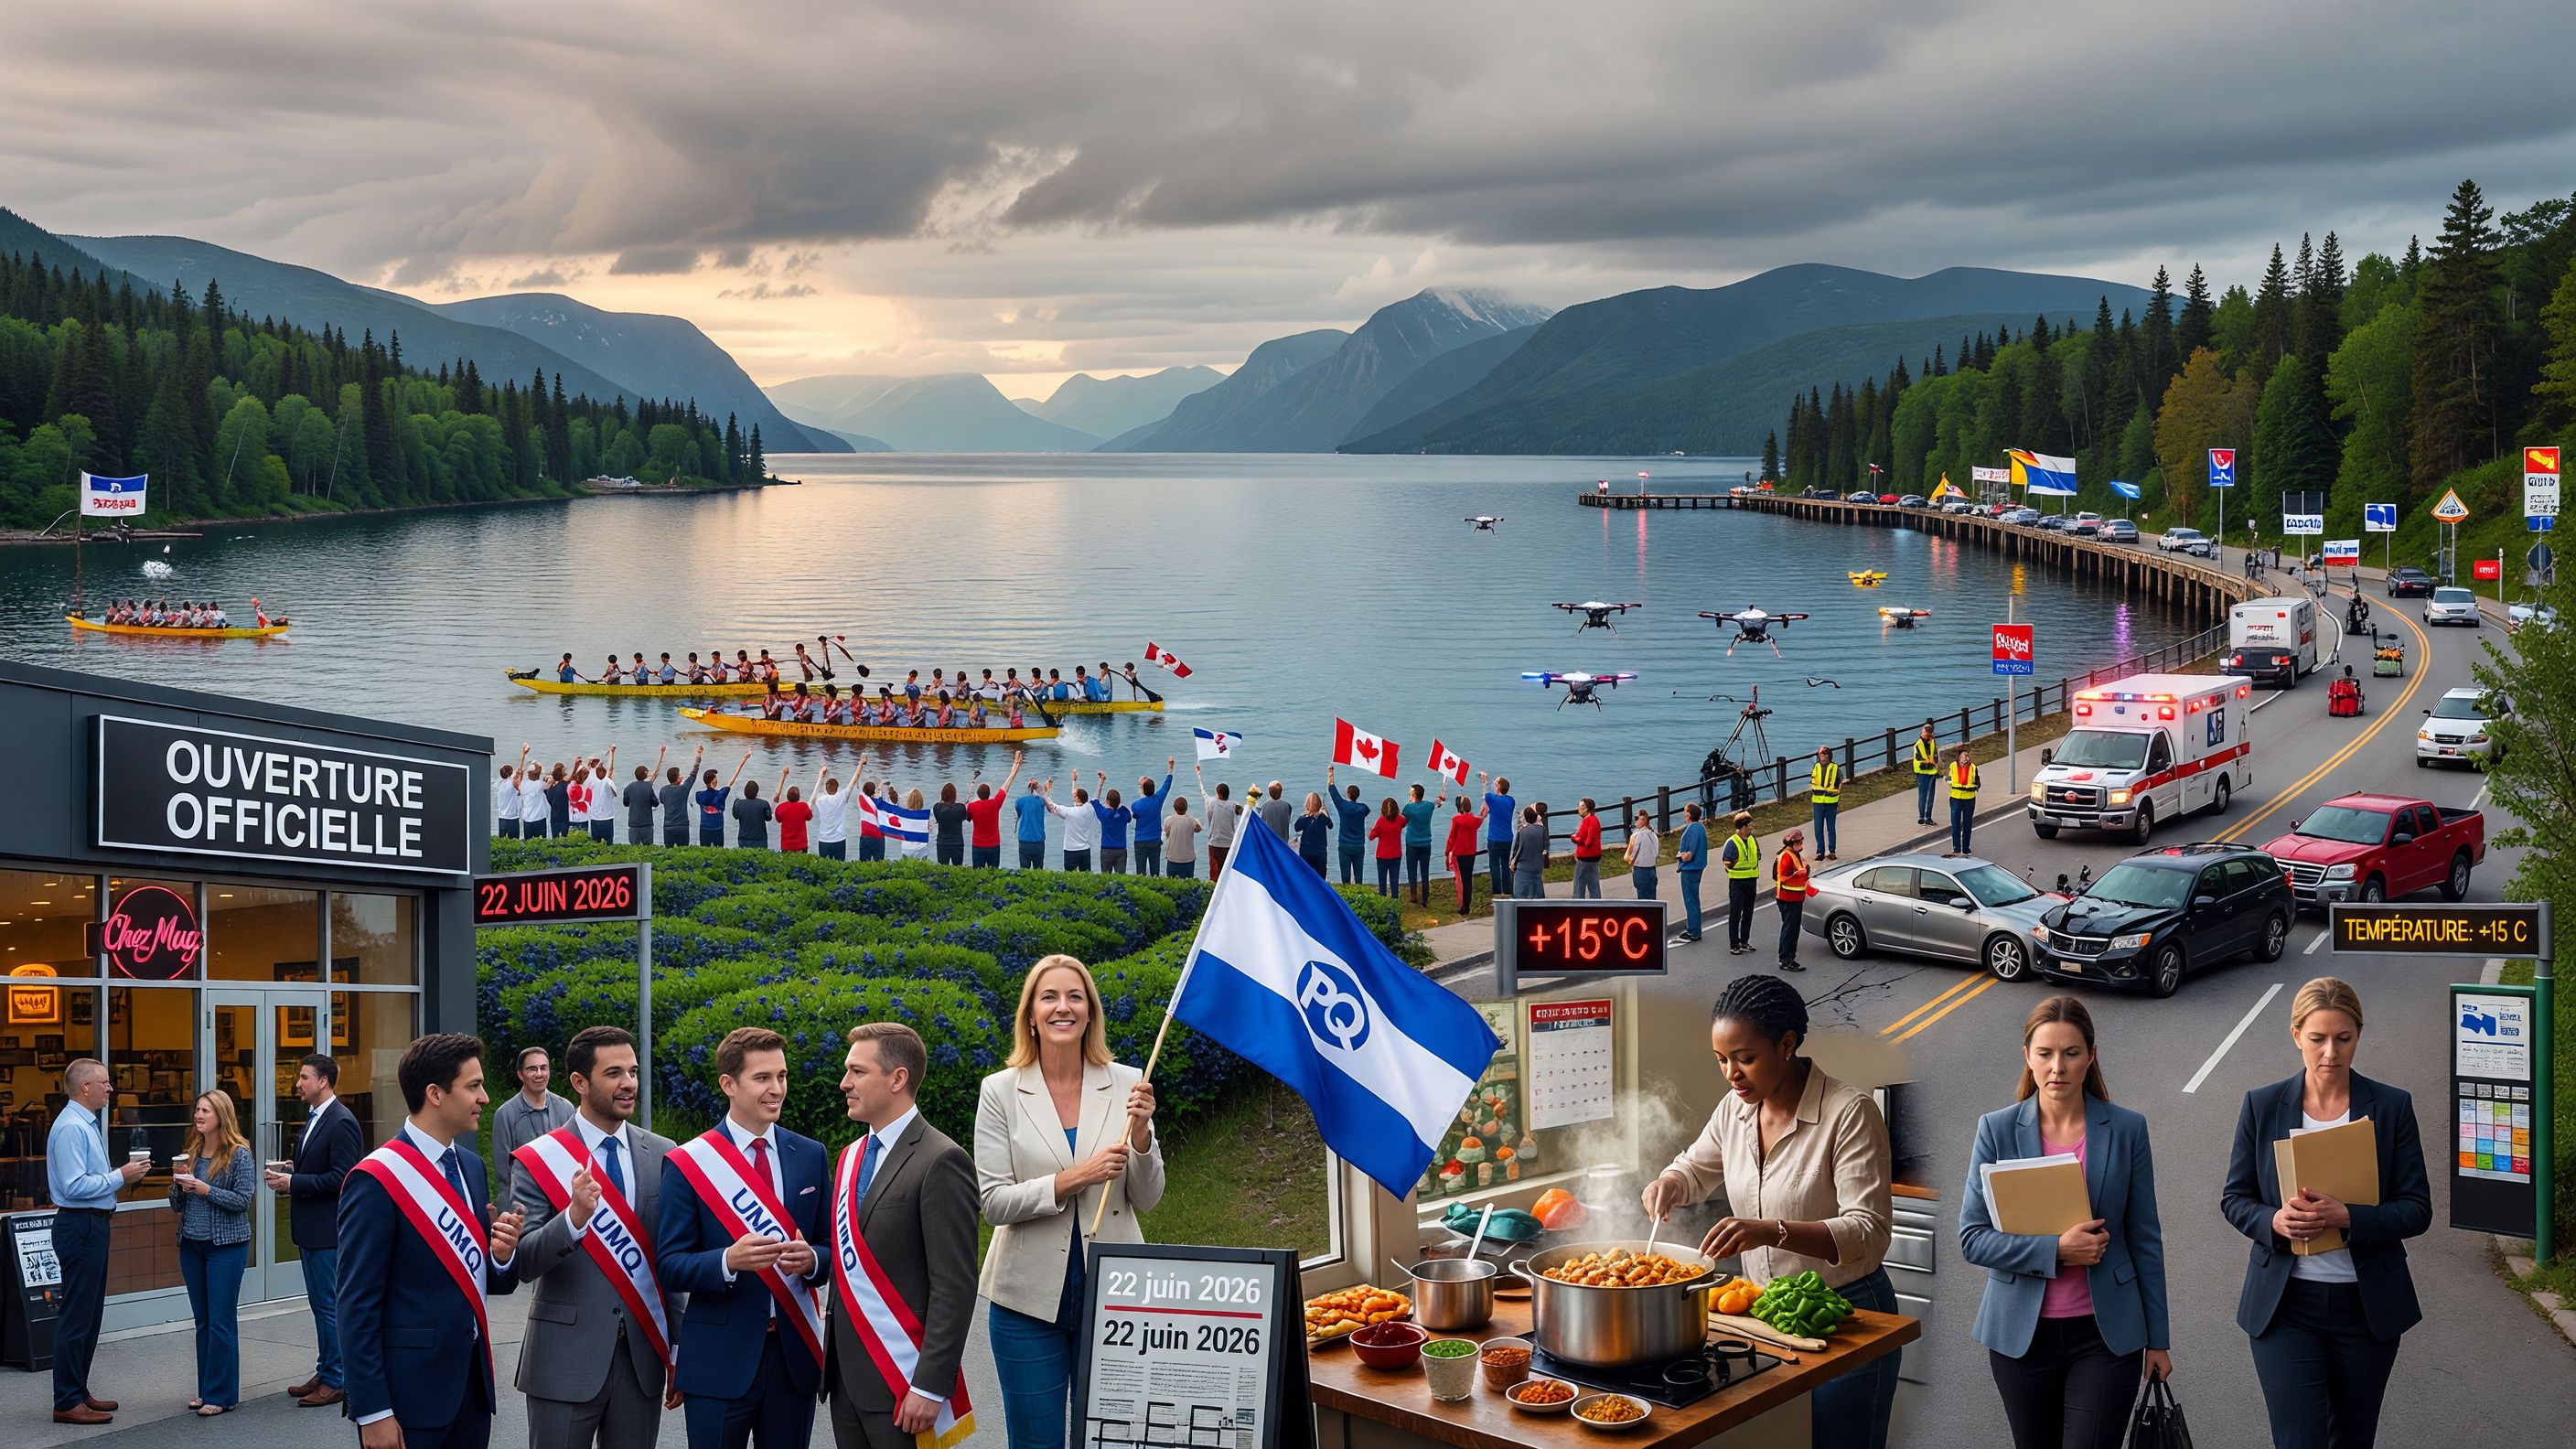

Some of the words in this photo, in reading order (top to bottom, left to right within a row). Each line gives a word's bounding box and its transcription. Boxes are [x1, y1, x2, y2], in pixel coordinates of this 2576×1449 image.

[166, 739, 424, 810] OUVERTURE
[166, 792, 423, 857] OFFICIELLE
[481, 884, 508, 916] 22
[514, 880, 566, 914] JUIN
[574, 875, 630, 910] 2026
[104, 913, 152, 950] Chez
[134, 915, 200, 963] Mug
[1529, 917, 1648, 960] +15°C
[2344, 914, 2474, 942] TEMPÉRATURE:
[2478, 919, 2508, 942] +15
[2514, 919, 2528, 942] C
[1300, 961, 1365, 1050] PQ
[438, 1206, 482, 1279] UMQ
[592, 1208, 642, 1278] UMQ
[1107, 1272, 1137, 1296] 22
[1142, 1272, 1190, 1304] juin
[1197, 1275, 1261, 1304] 2026
[1102, 1319, 1134, 1347] 22
[1138, 1322, 1188, 1356] juin
[1196, 1325, 1260, 1355] 2026
